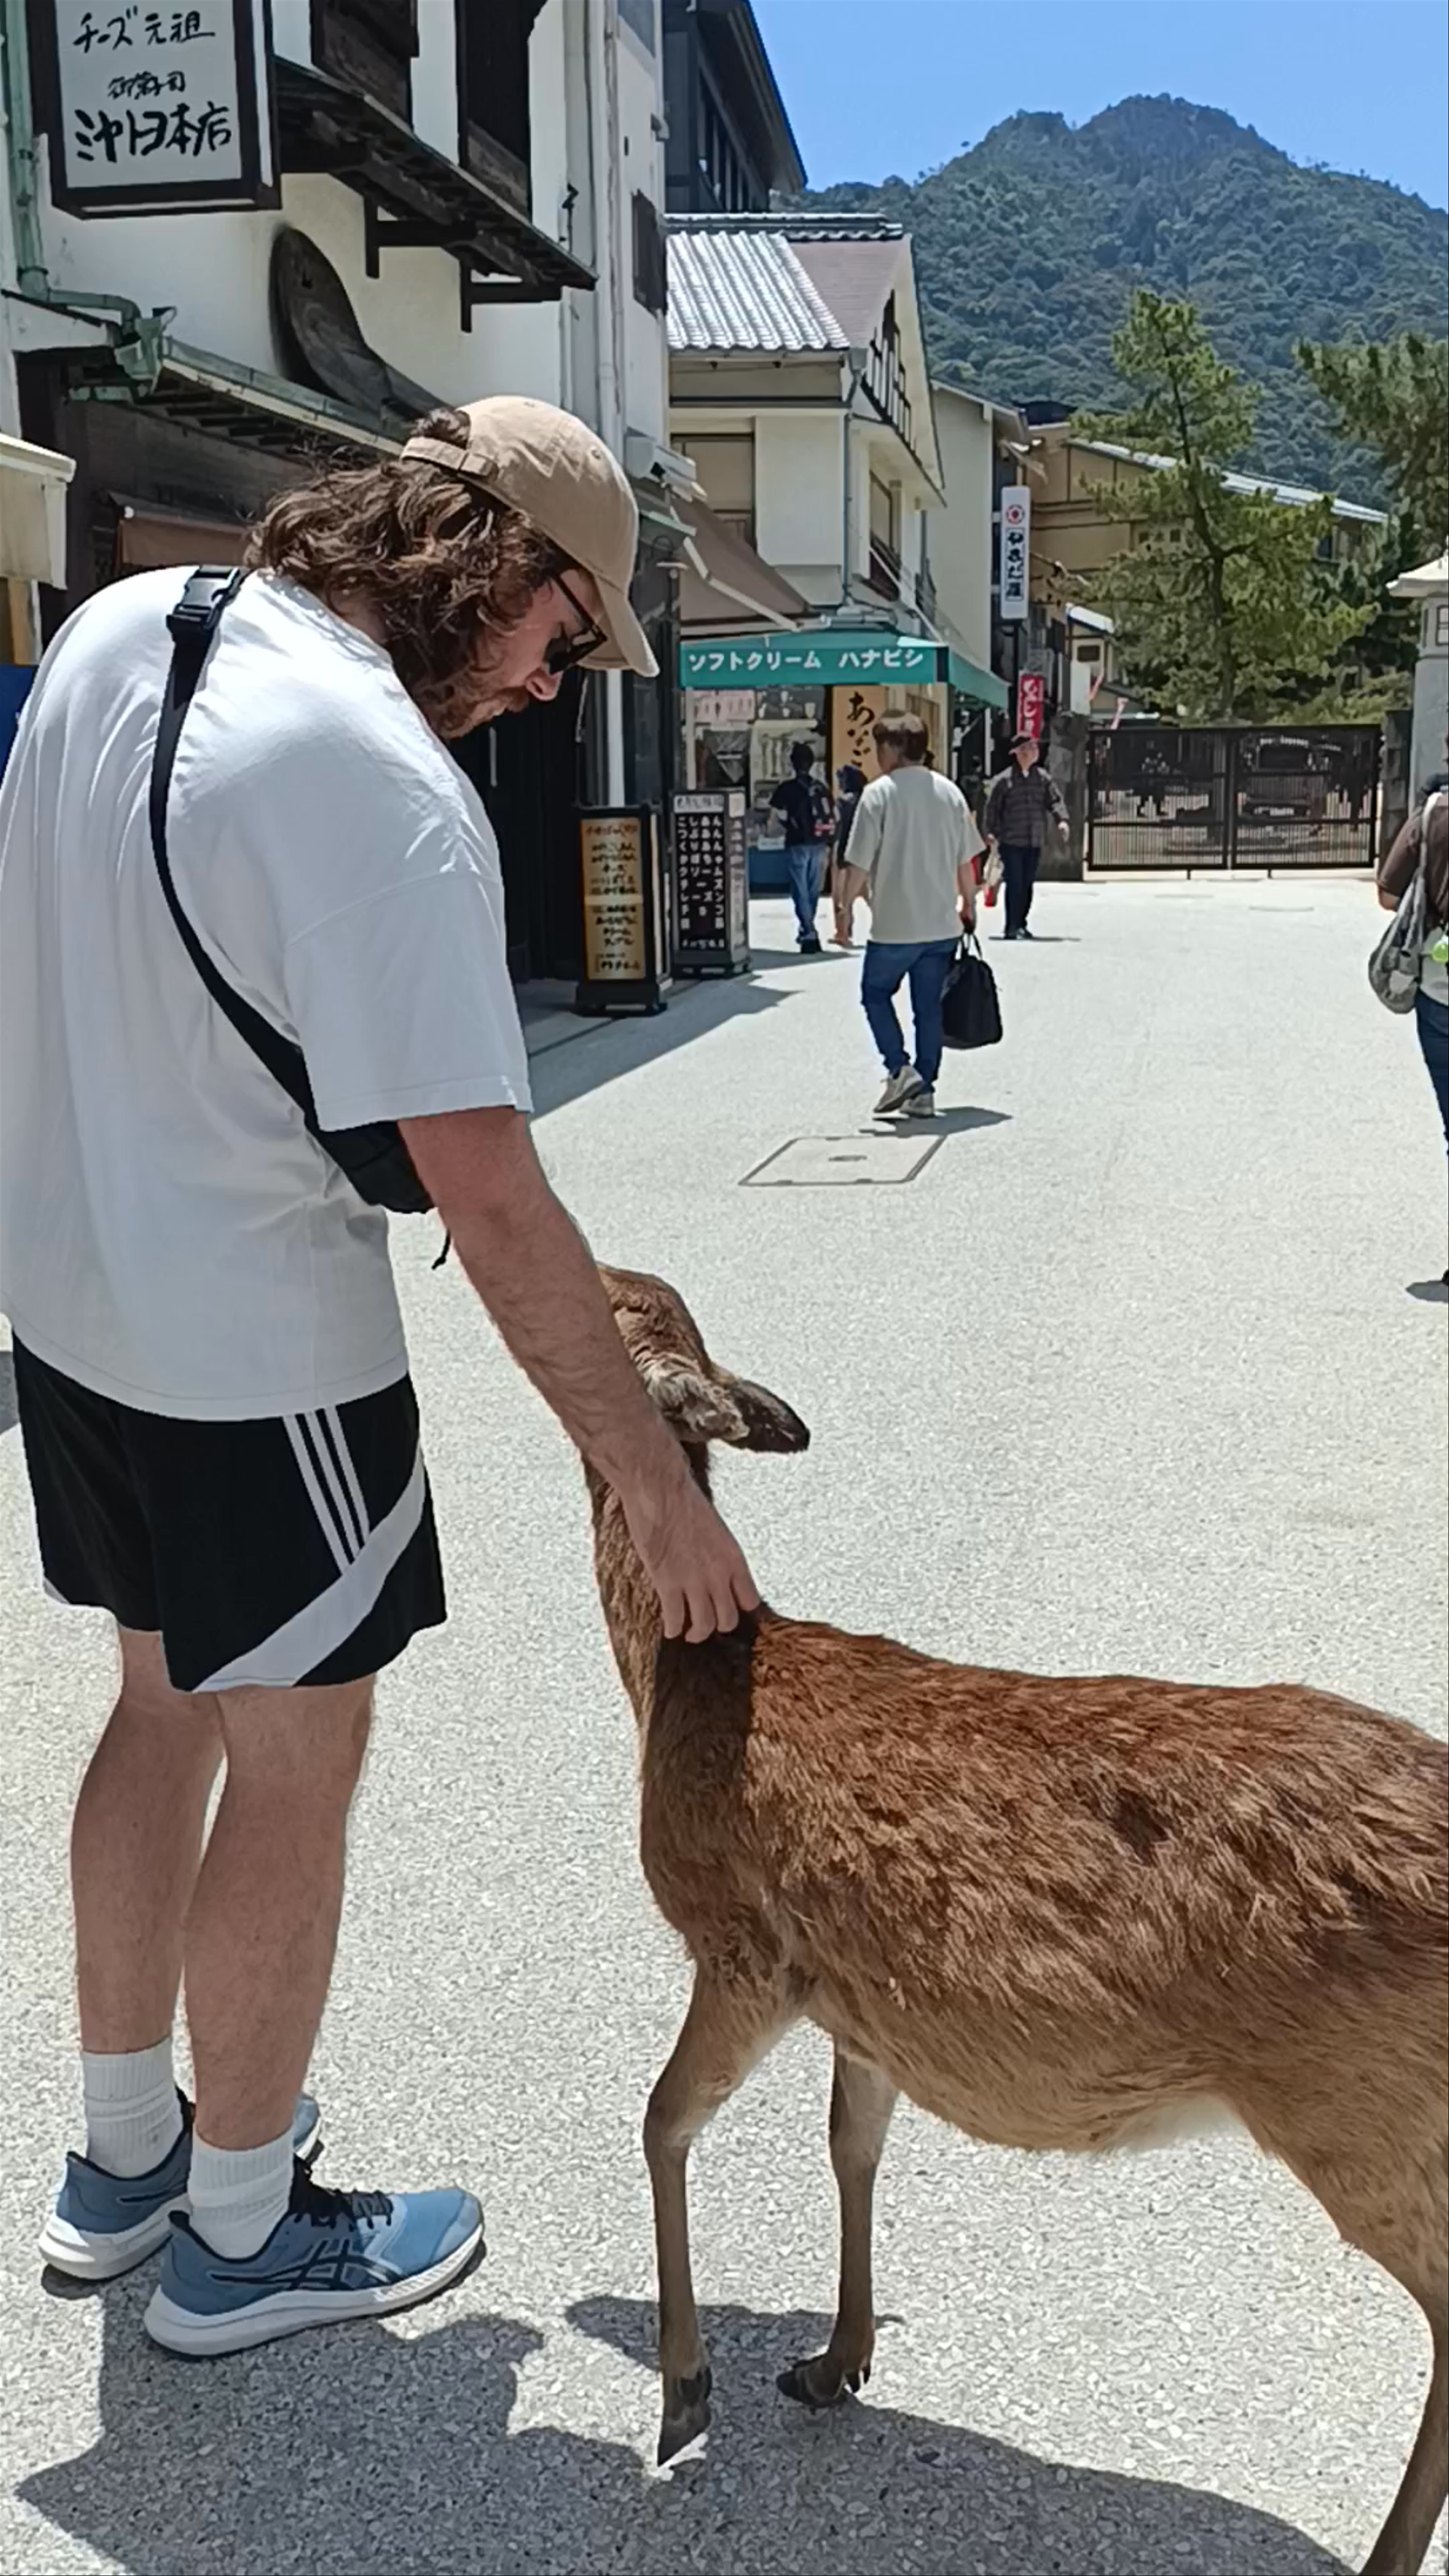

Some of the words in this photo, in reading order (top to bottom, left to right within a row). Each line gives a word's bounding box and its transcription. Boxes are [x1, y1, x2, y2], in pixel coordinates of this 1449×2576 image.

[74, 101, 232, 163] ミヤトヨ本店
[689, 650, 822, 671] ソフトクリーム
[838, 649, 923, 669] ハナビシ
[678, 815, 722, 827] こしあん
[679, 866, 724, 877] クリーム
